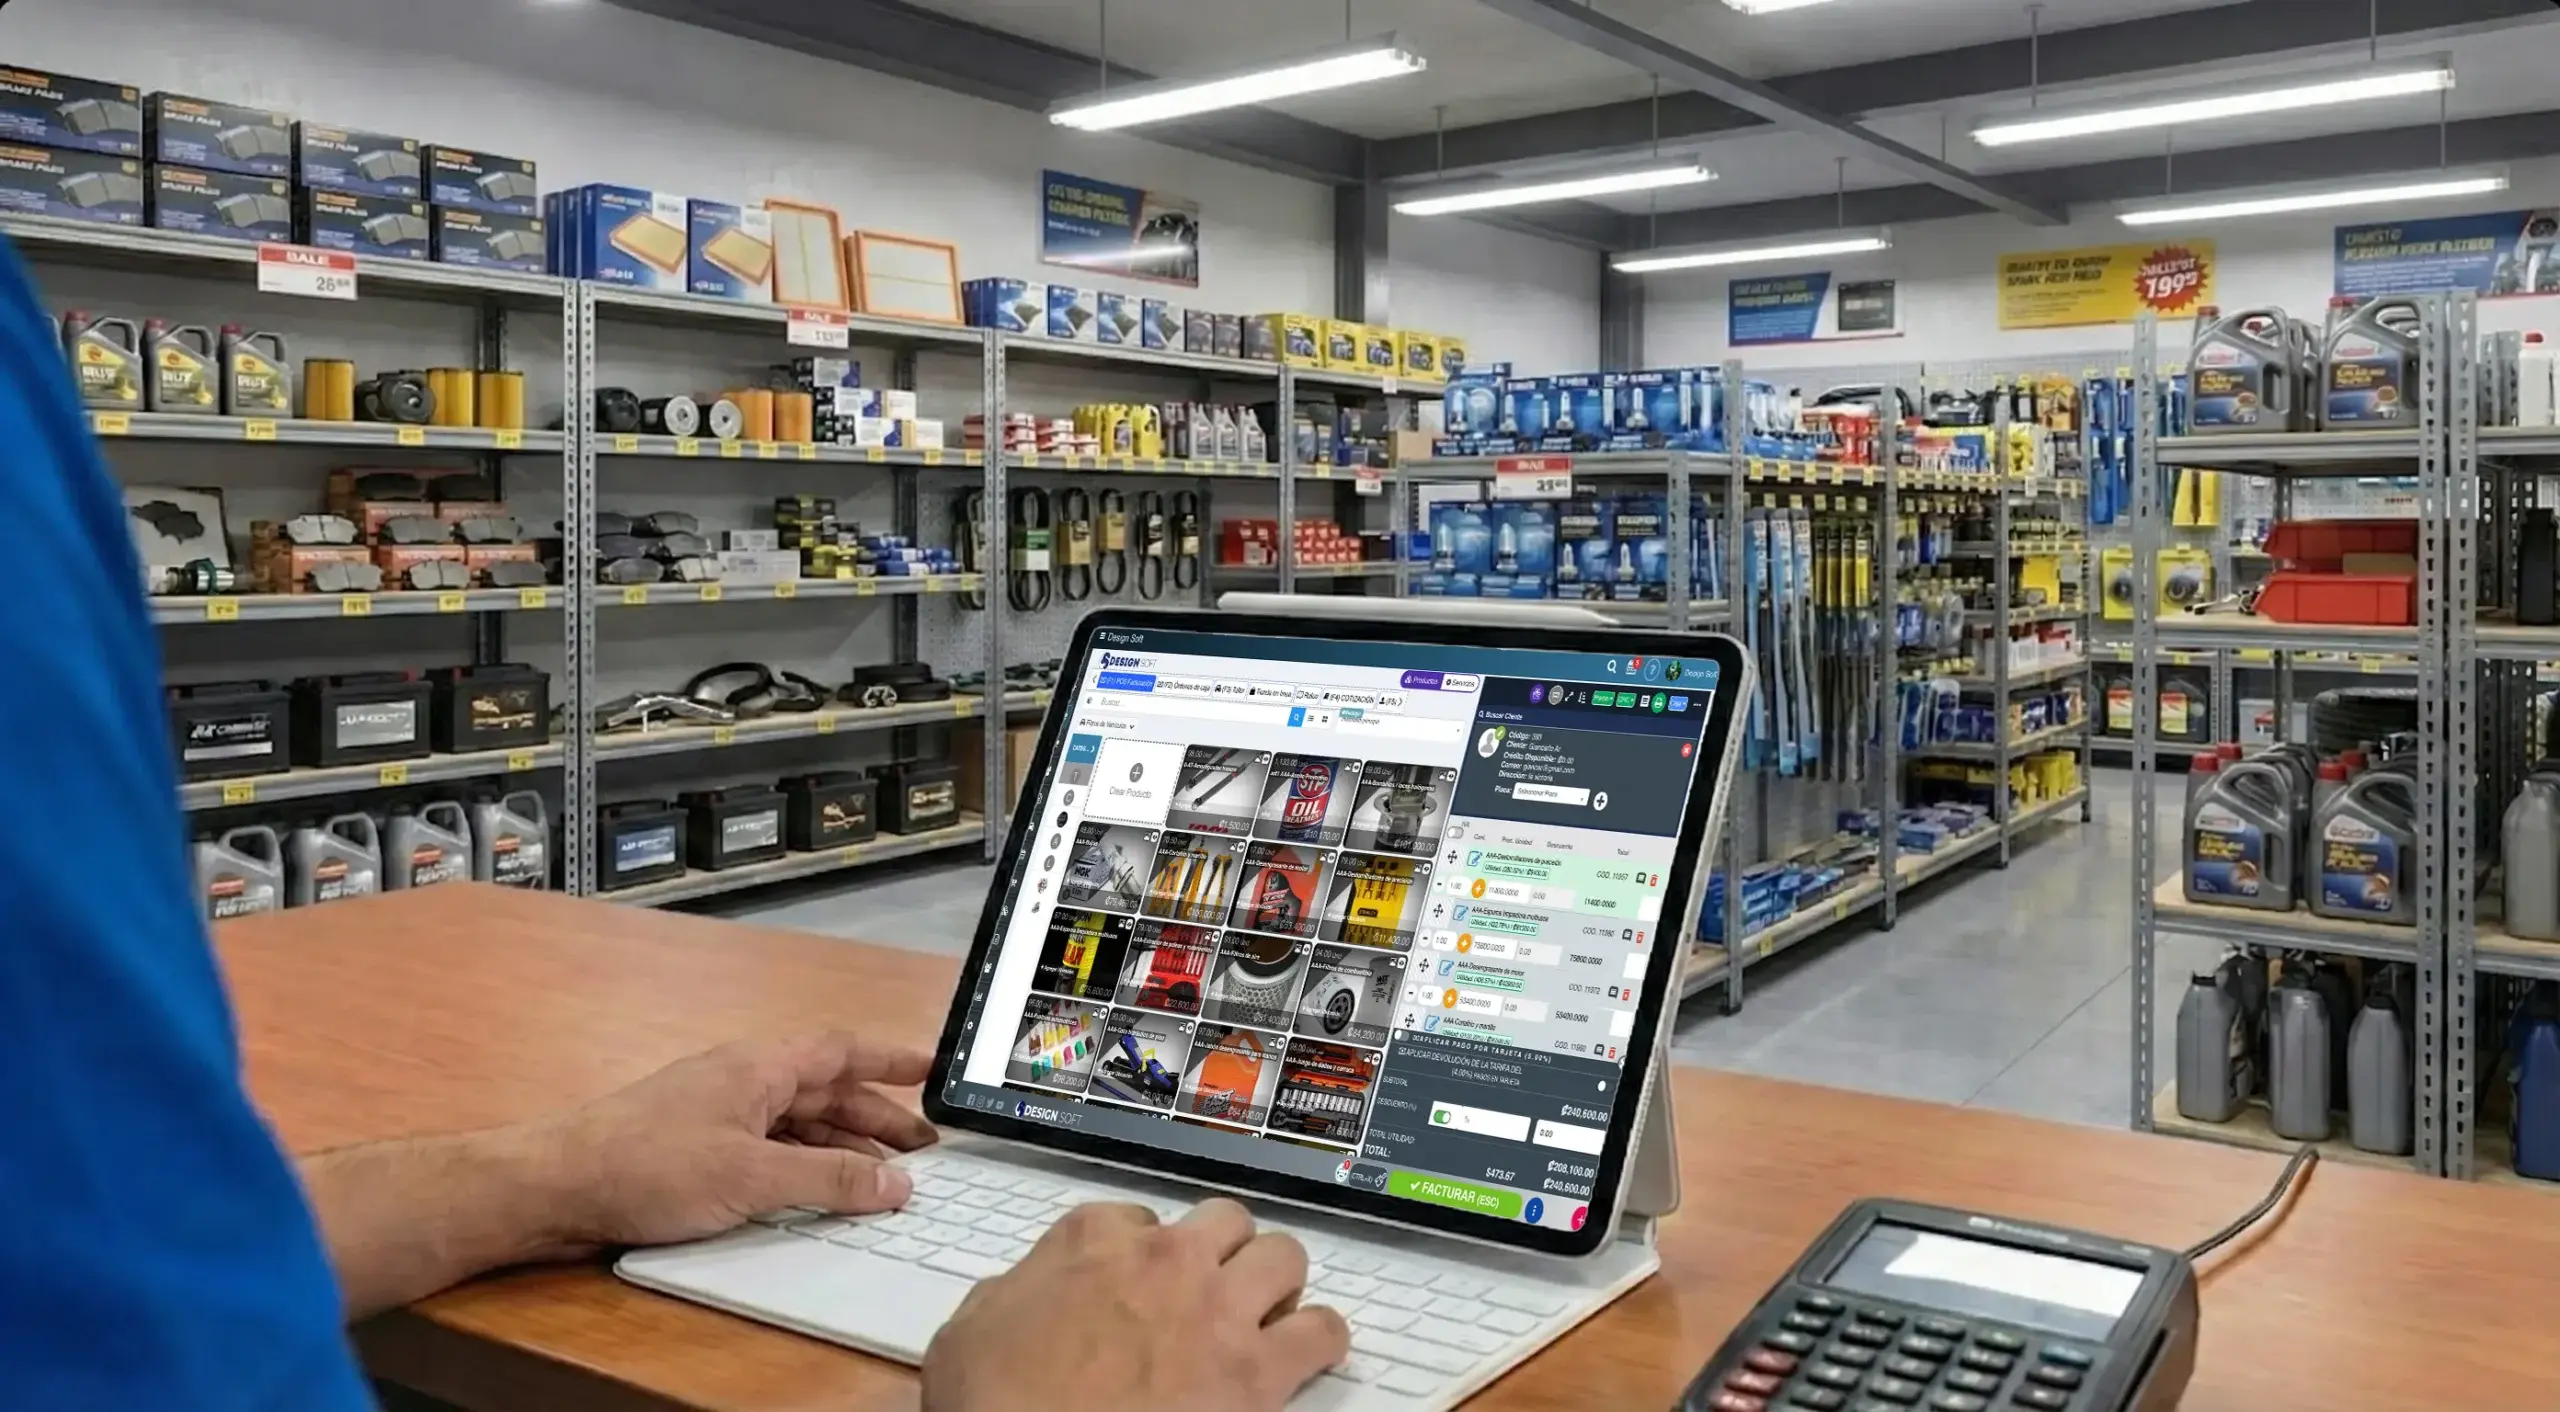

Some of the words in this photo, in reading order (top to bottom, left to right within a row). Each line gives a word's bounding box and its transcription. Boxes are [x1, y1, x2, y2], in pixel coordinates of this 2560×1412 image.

[1106, 632, 1130, 644] Design
[1108, 656, 1140, 667] DESIGN
[1139, 658, 1157, 668] SOFT
[1683, 668, 1705, 678] Design
[1412, 676, 1439, 684] Productos
[1451, 679, 1475, 687] Servicios
[1485, 710, 1505, 719] Buscar
[1504, 712, 1524, 721] Cliente
[1505, 740, 1528, 749] Cliente:
[1291, 801, 1321, 817] OIL
[1073, 866, 1091, 877] NGK
[1451, 1041, 1471, 1050] PAGO
[1490, 1047, 1522, 1058] TARJETA
[1405, 1048, 1431, 1059] APLICAR
[1430, 1050, 1471, 1066] DEVOLUCIÓN
[1382, 1075, 1409, 1087] SUBTOTAL
[1023, 1104, 1058, 1121] DESIGN
[1058, 1111, 1082, 1127] SOFT
[1368, 1128, 1388, 1139] TOTAL
[1363, 1143, 1392, 1159] TOTAL:
[1485, 1166, 1515, 1182] $473.67
[1420, 1180, 1476, 1204] FACTURAR
[1475, 1193, 1500, 1210] (ESC)
